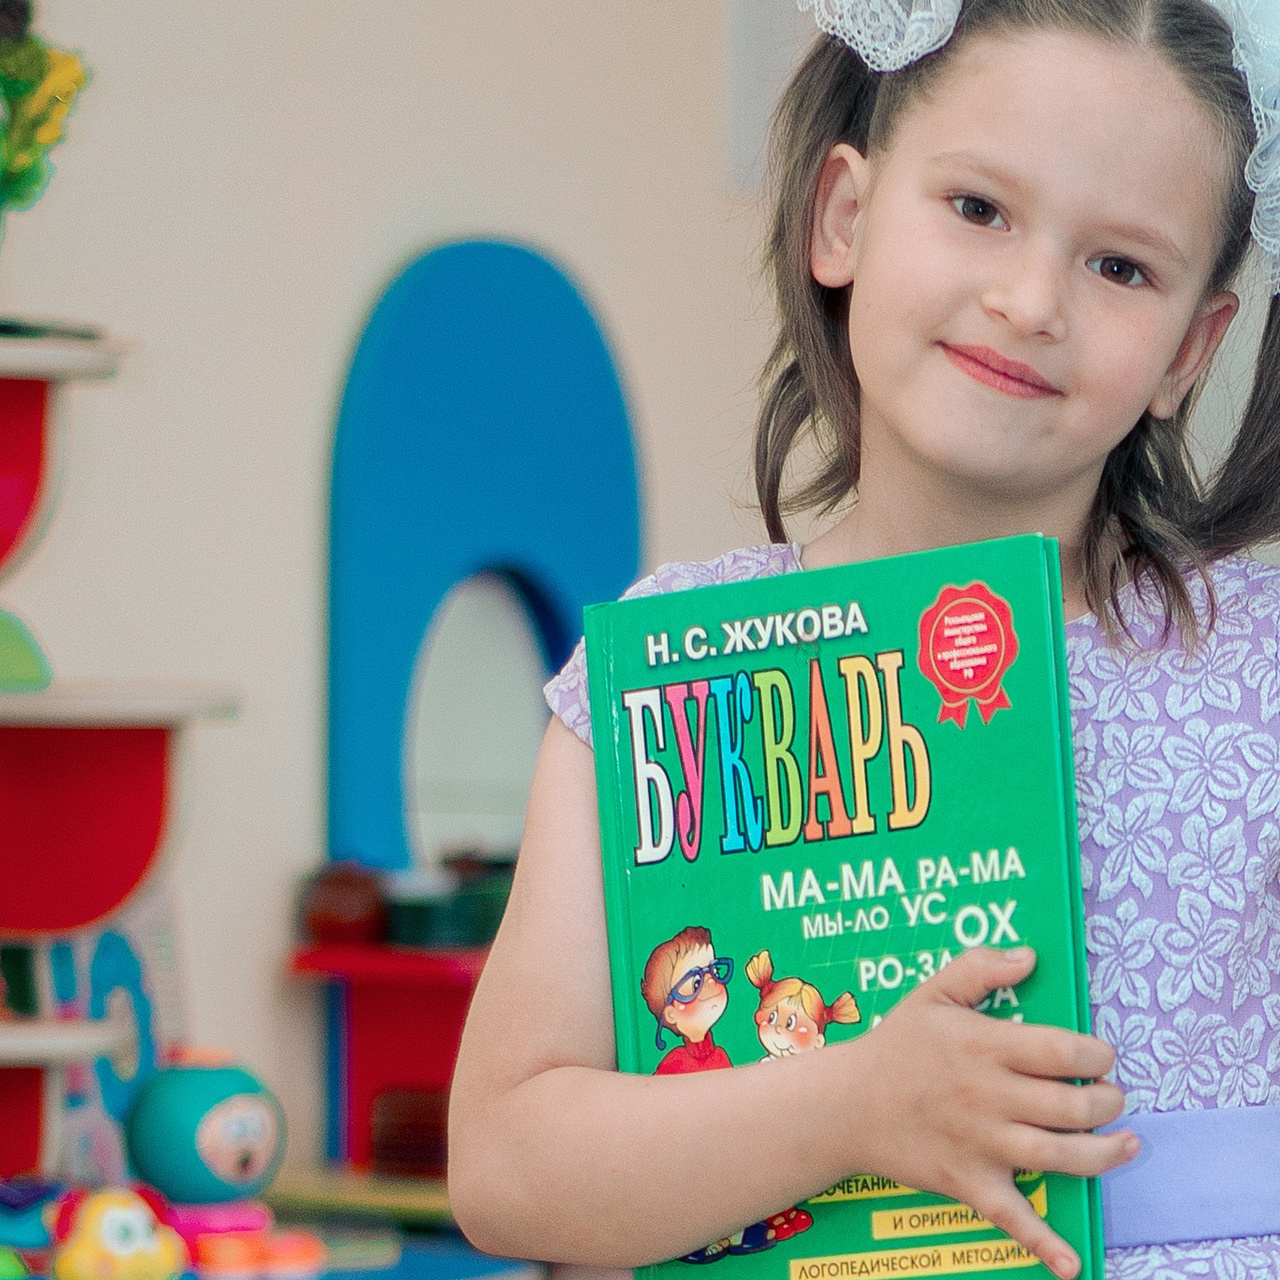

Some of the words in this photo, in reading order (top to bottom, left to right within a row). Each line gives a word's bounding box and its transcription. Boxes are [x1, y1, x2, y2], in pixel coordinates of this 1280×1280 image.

[646, 632, 680, 667] Н.
[683, 625, 718, 660] С.
[721, 601, 869, 654] ЖУКОВА
[622, 649, 932, 867] БУКВАРЬ
[760, 857, 906, 911] МА-МА
[917, 846, 1026, 891] РА-МА
[801, 905, 890, 939] МЫ-ЛО
[901, 892, 947, 927] УС
[953, 900, 1021, 948] ОХ
[815, 1176, 899, 1197] ОЧЕТАНИ
[893, 1214, 904, 1230] И
[909, 1207, 984, 1229] ОРИГИНА
[798, 1249, 942, 1280] ЛОГОПЕДИЧЕСКОЙ
